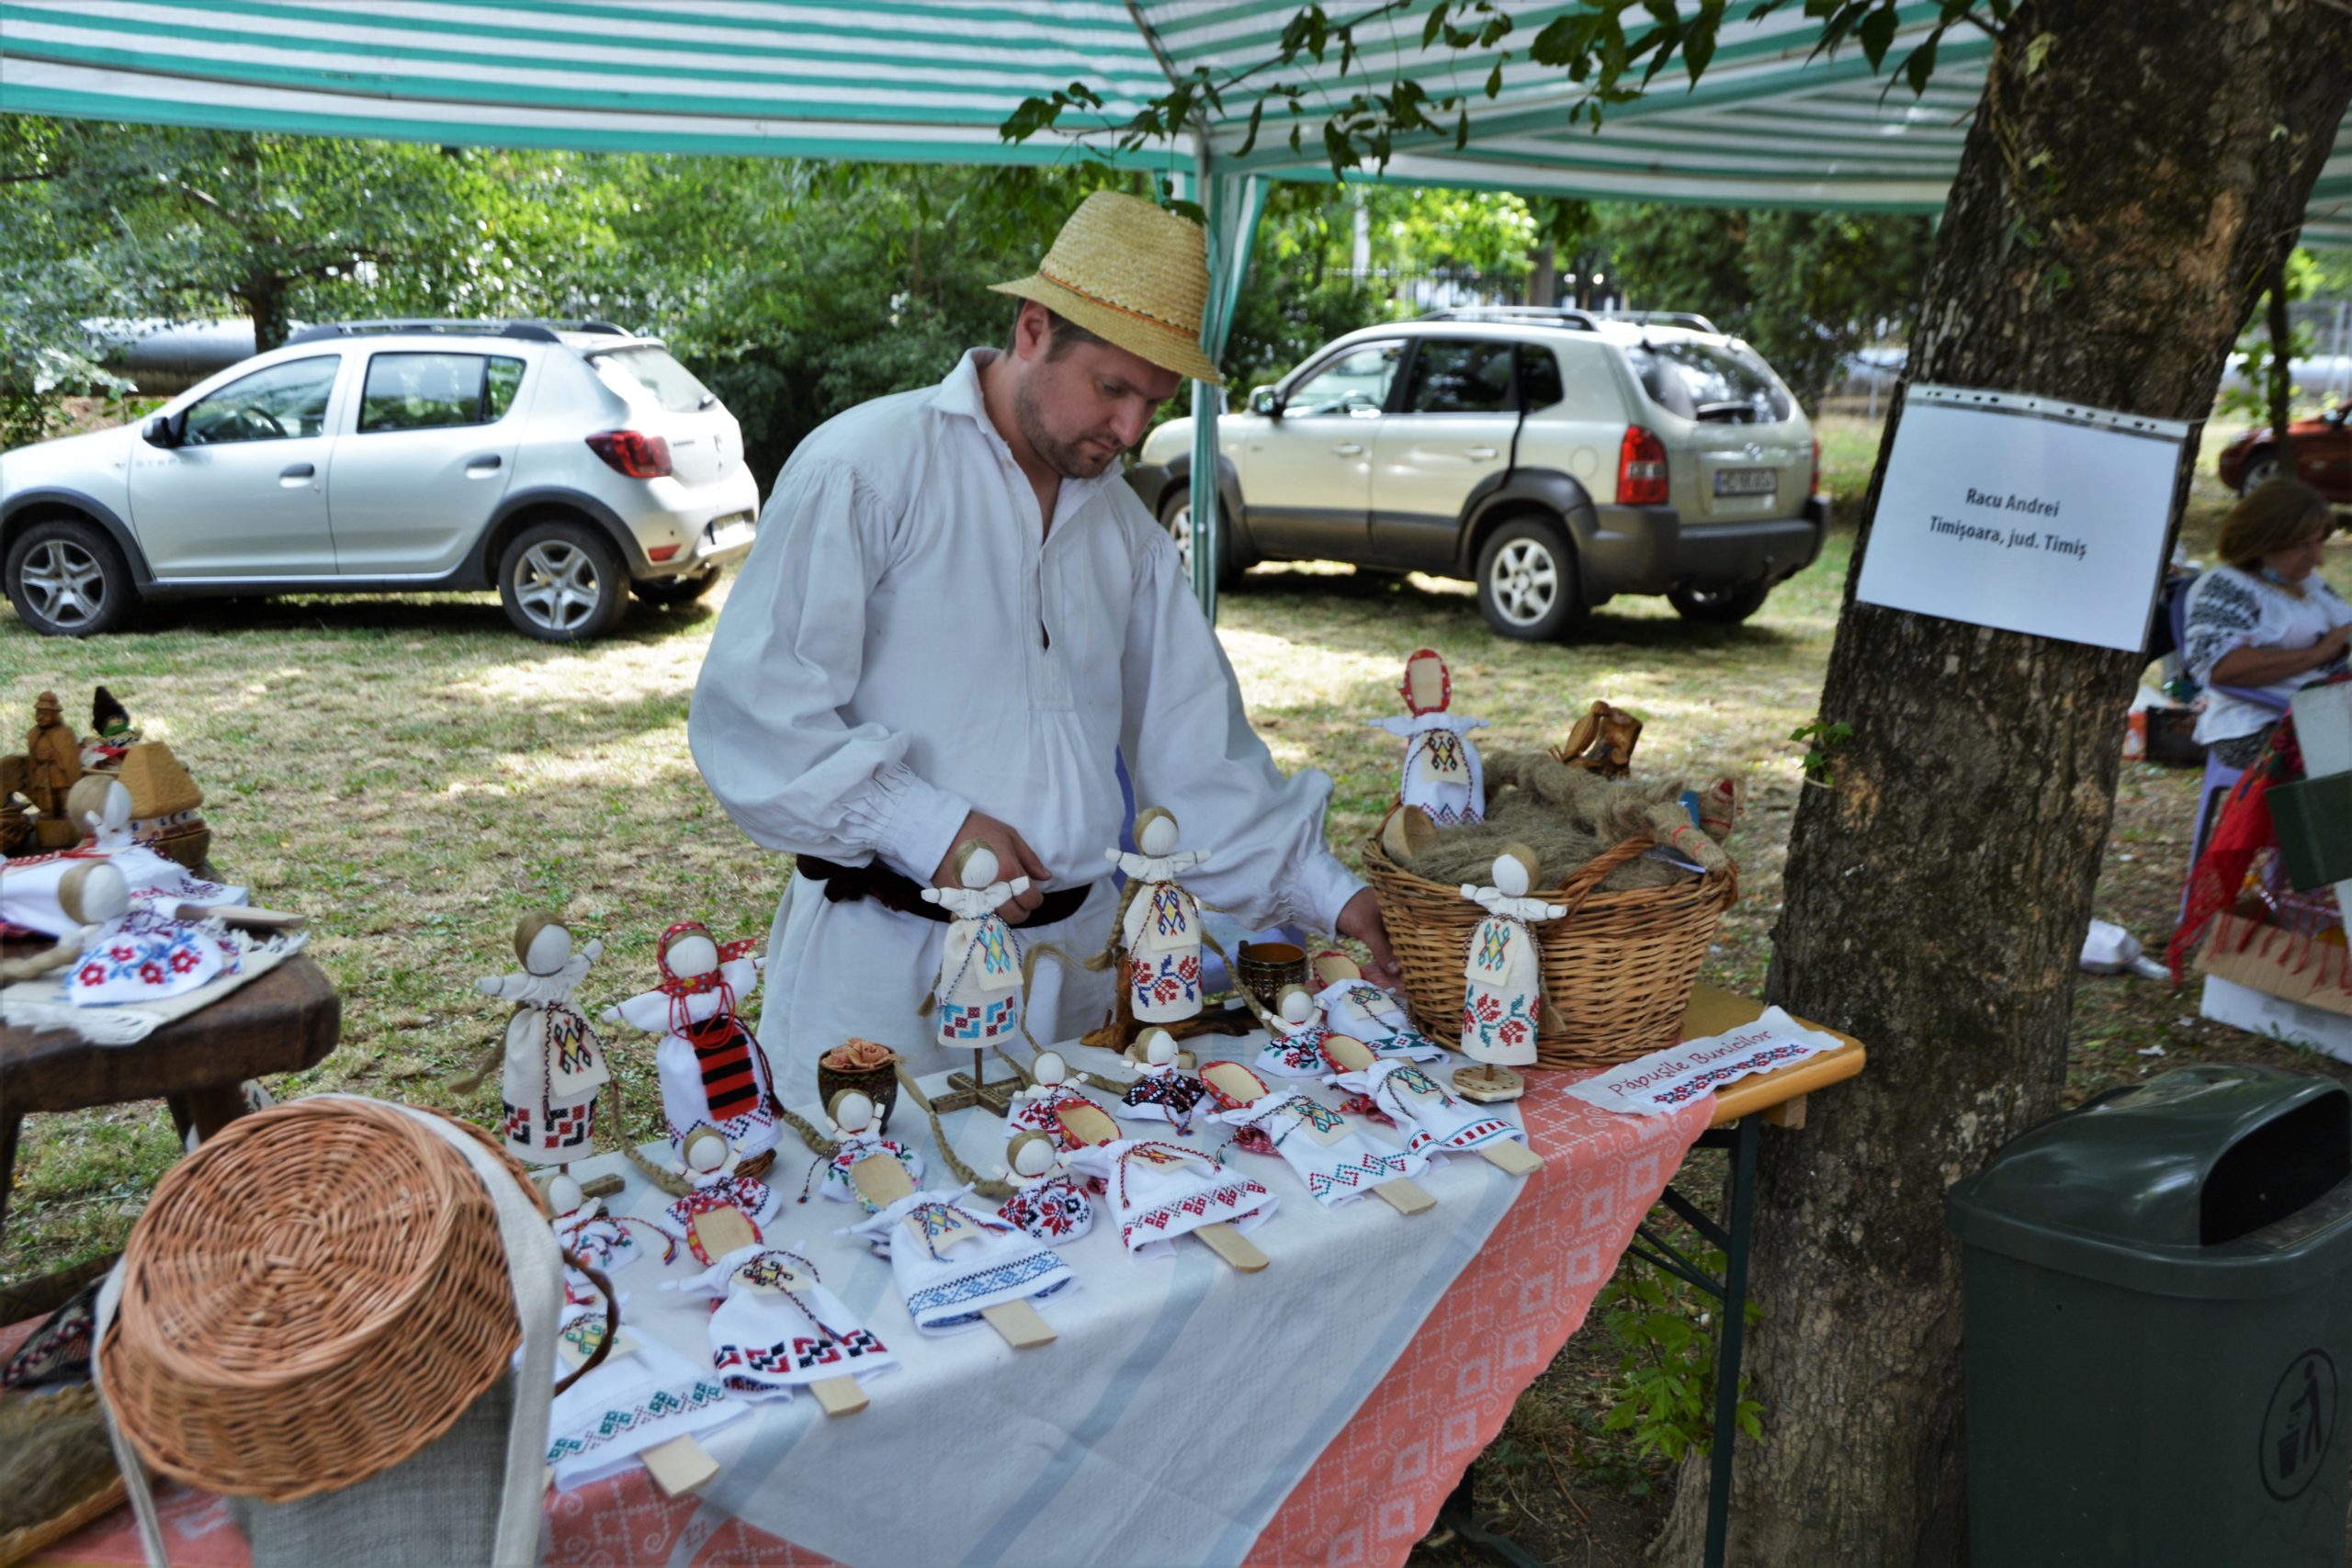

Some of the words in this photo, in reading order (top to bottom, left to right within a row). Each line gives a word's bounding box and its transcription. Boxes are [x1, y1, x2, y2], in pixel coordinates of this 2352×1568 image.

[1966, 488, 2003, 509] Racu
[2005, 494, 2061, 517] Andrei
[2007, 528, 2040, 549] jud.
[1689, 1031, 1773, 1065] Bunicilor
